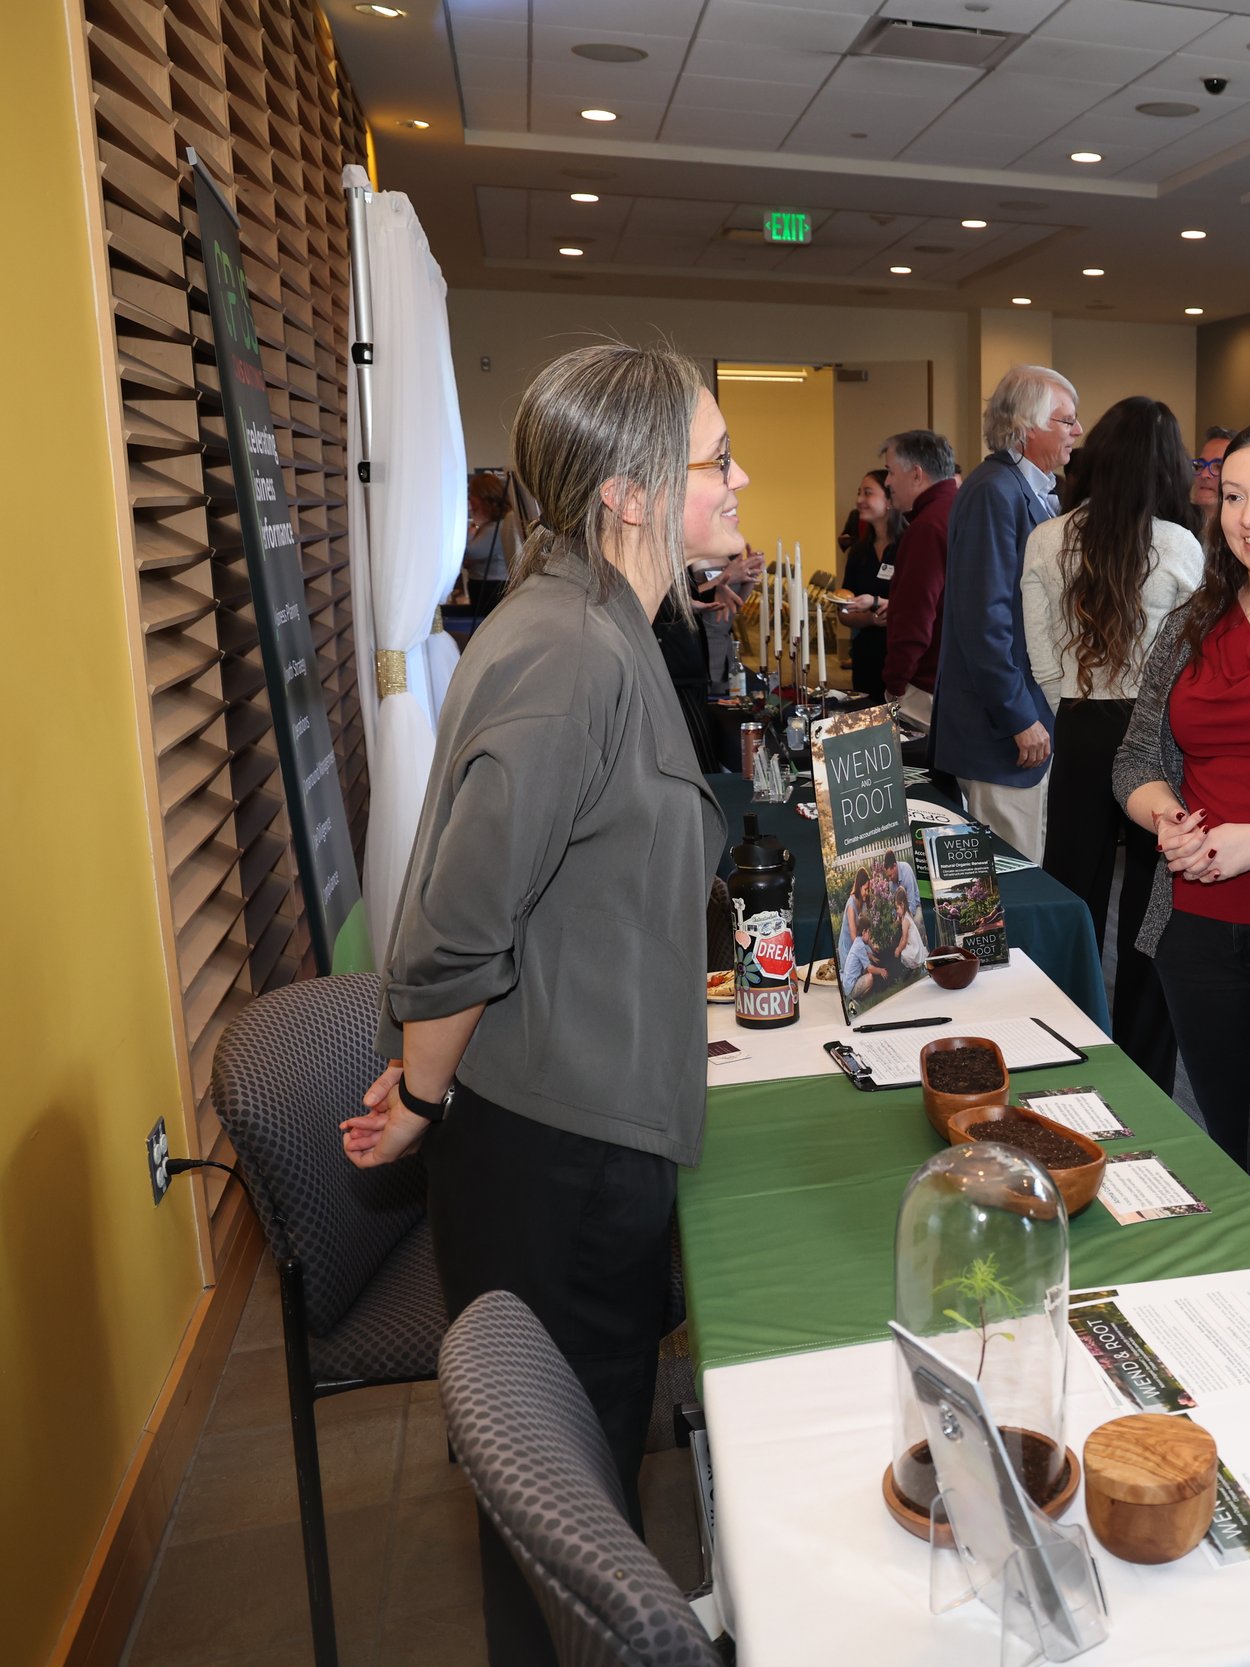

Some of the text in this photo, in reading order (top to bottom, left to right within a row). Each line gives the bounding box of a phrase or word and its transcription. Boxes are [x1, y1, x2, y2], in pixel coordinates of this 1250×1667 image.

[772, 212, 806, 241] EXIT
[830, 743, 892, 784] WEND
[860, 778, 872, 789] AND
[841, 783, 894, 826] ROOT
[944, 838, 980, 849] WEND
[947, 850, 979, 861] ROOT
[966, 934, 997, 946] WEND
[970, 945, 996, 956] ROOT
[736, 990, 792, 1016] ANGRY
[1086, 1319, 1160, 1399] WEND & ROOT
[1211, 1500, 1242, 1540] WEN
